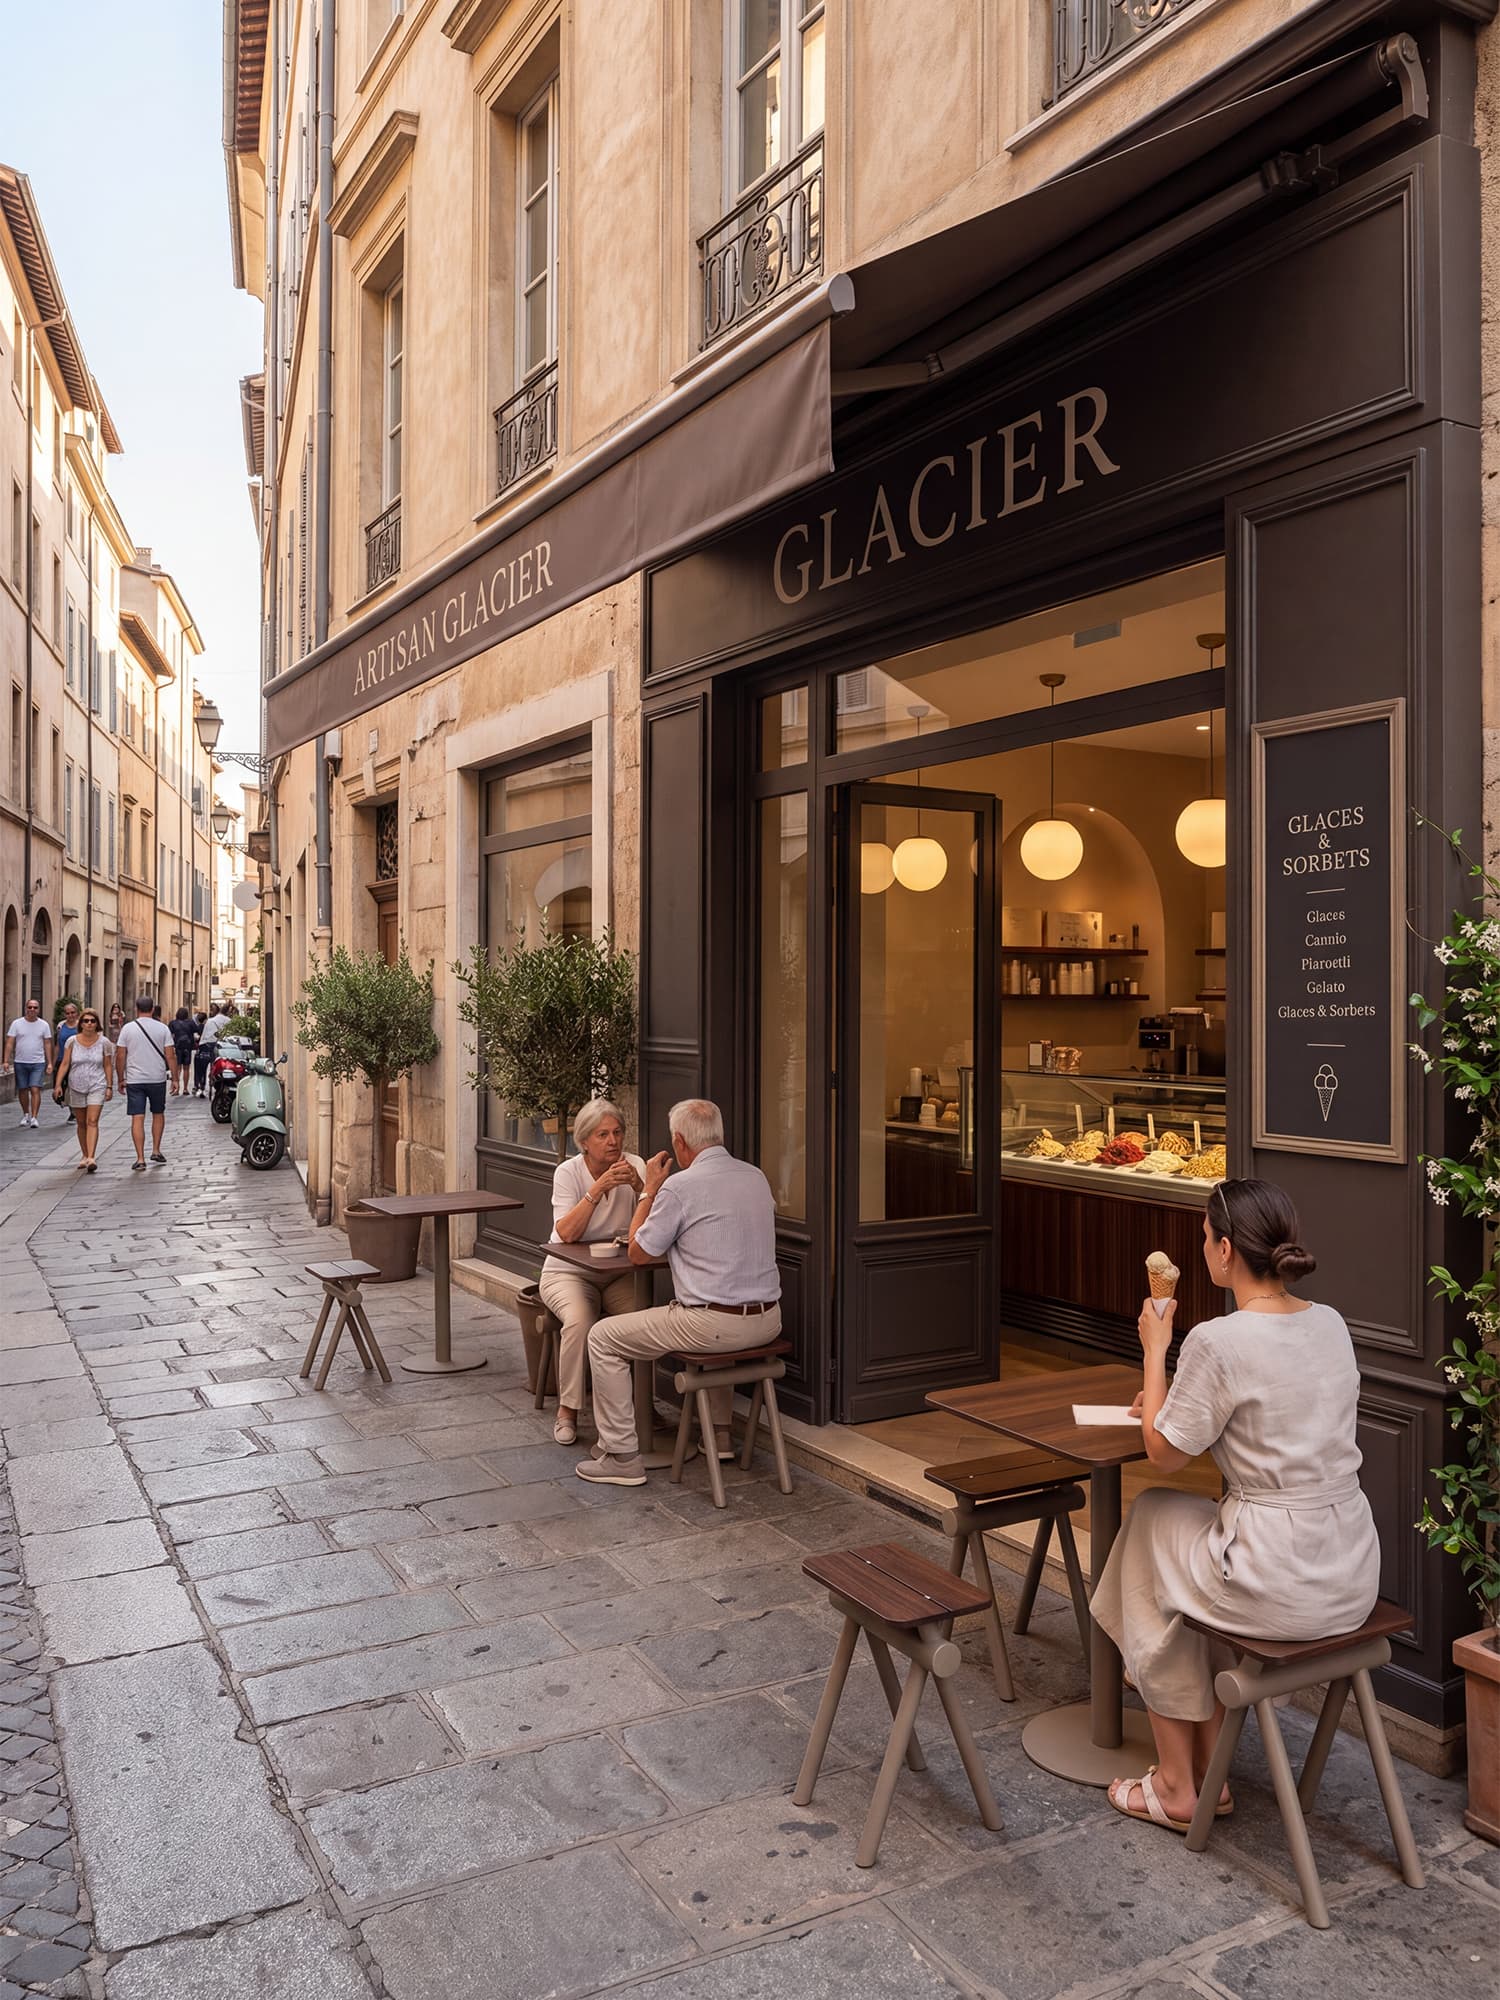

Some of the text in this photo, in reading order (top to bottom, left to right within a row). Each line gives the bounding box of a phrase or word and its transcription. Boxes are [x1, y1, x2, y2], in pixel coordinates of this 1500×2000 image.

[774, 387, 1120, 604] GLACIER
[353, 541, 553, 695] ARTISAN GLACIER
[1288, 806, 1364, 834] GLACES
[1318, 833, 1331, 849] &
[1283, 848, 1370, 876] SORBETS
[1306, 910, 1346, 923] Glaces
[1305, 932, 1347, 946] Cannio
[1306, 981, 1345, 994] Gelato
[1278, 1003, 1376, 1018] Glaces & Sorbets
